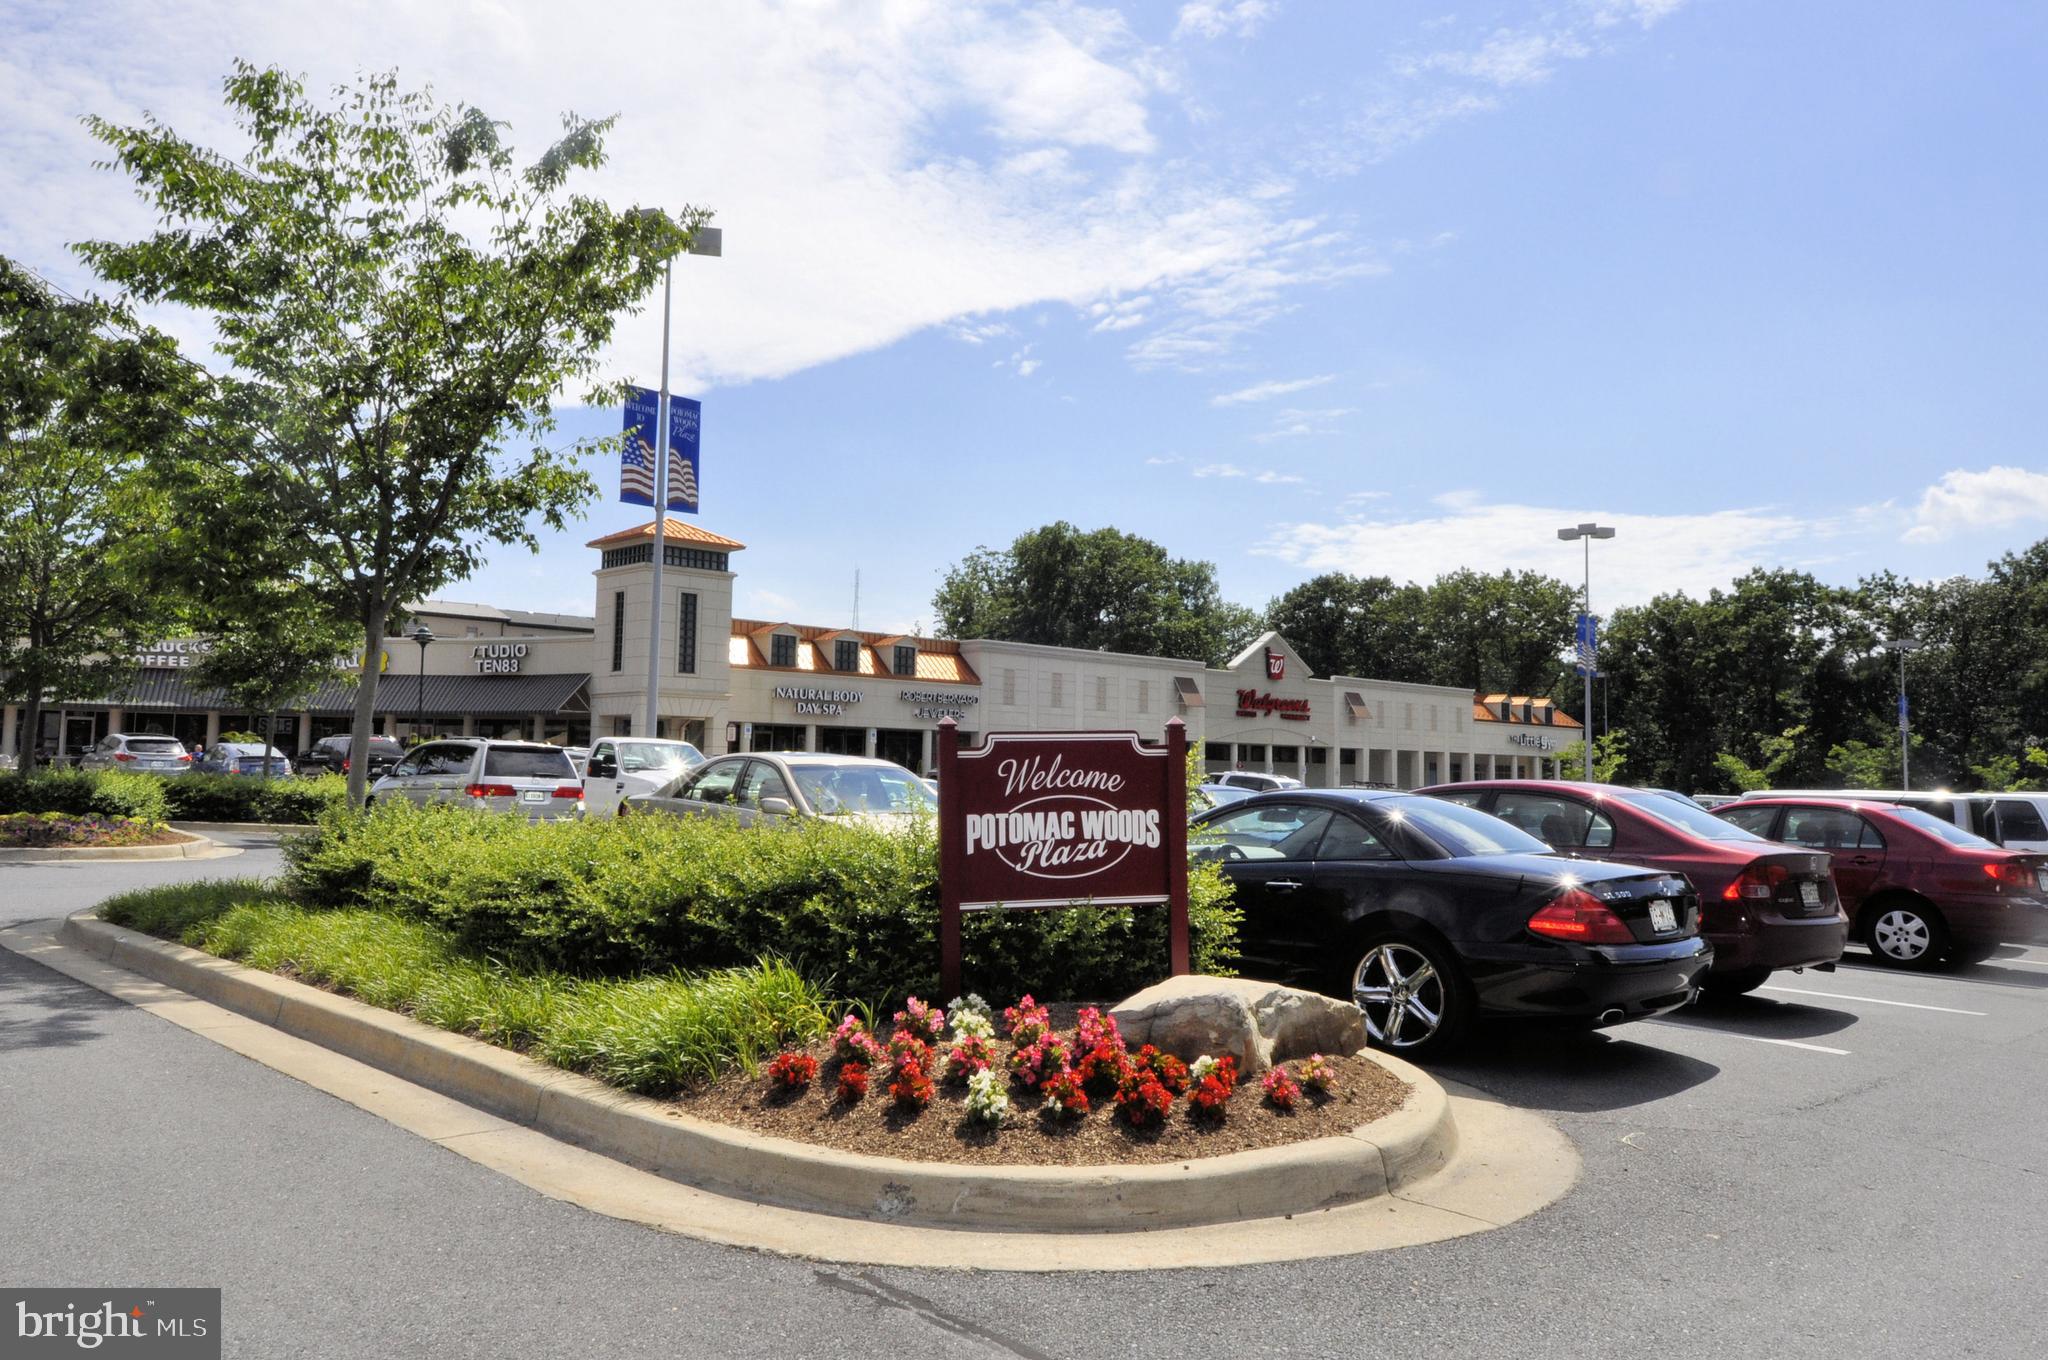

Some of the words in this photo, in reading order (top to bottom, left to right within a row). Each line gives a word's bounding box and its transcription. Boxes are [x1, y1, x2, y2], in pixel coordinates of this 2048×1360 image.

[625, 402, 656, 416] WELCOME
[671, 406, 700, 420] POTOMAC
[636, 414, 645, 422] TO
[673, 416, 698, 427] WOODS
[469, 644, 527, 658] STUDIO
[475, 659, 519, 673] TEN83
[776, 686, 831, 702] NATURAL
[832, 690, 864, 703] BODY
[901, 690, 935, 703] ROBERT
[936, 692, 979, 705] BERNARD
[796, 702, 819, 714] DAY
[821, 703, 843, 716] SPA
[1236, 690, 1310, 717] Walgreens
[259, 719, 291, 733] SLE
[997, 753, 1126, 797] Welcome
[966, 811, 1075, 856] POTOMAC
[1081, 808, 1161, 849] WOODS
[1015, 838, 1108, 872] Plaza
